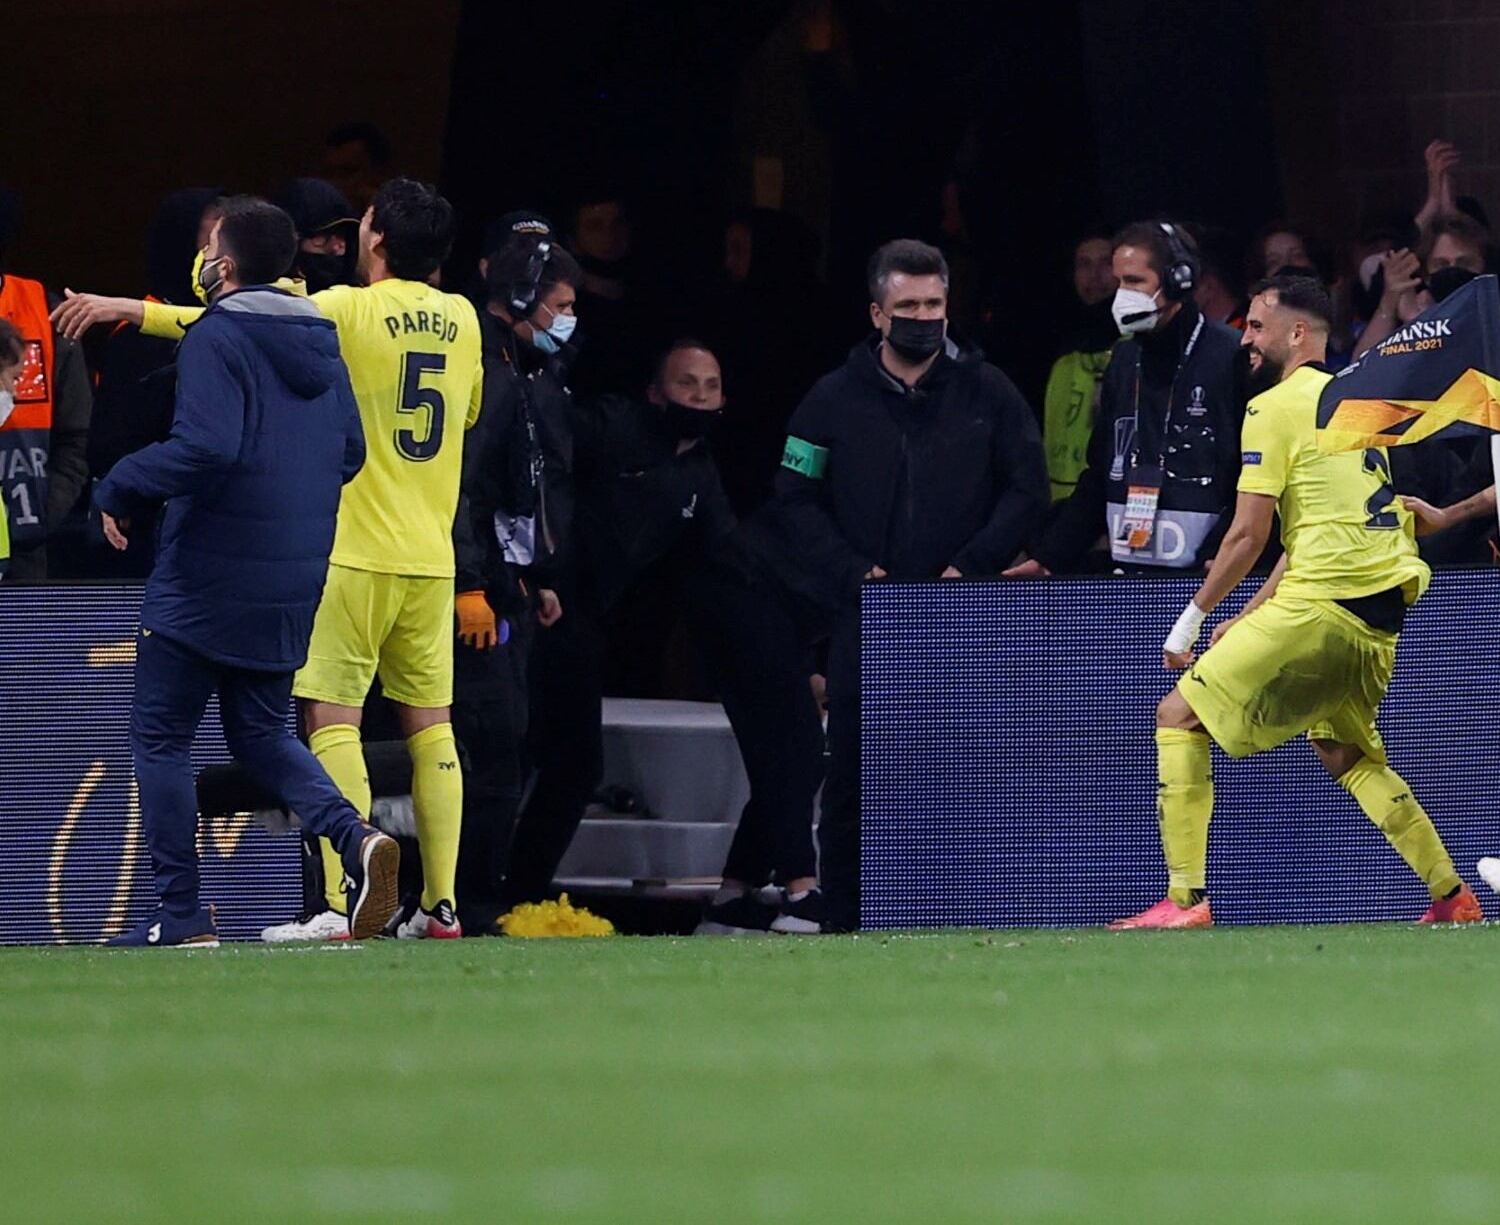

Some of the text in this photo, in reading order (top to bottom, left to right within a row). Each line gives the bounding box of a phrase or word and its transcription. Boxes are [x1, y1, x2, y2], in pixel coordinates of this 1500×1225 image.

[384, 310, 459, 343] PAREJO
[1380, 337, 1442, 357] FINAL 2021
[393, 351, 446, 462] 5
[1361, 447, 1402, 531] 2
